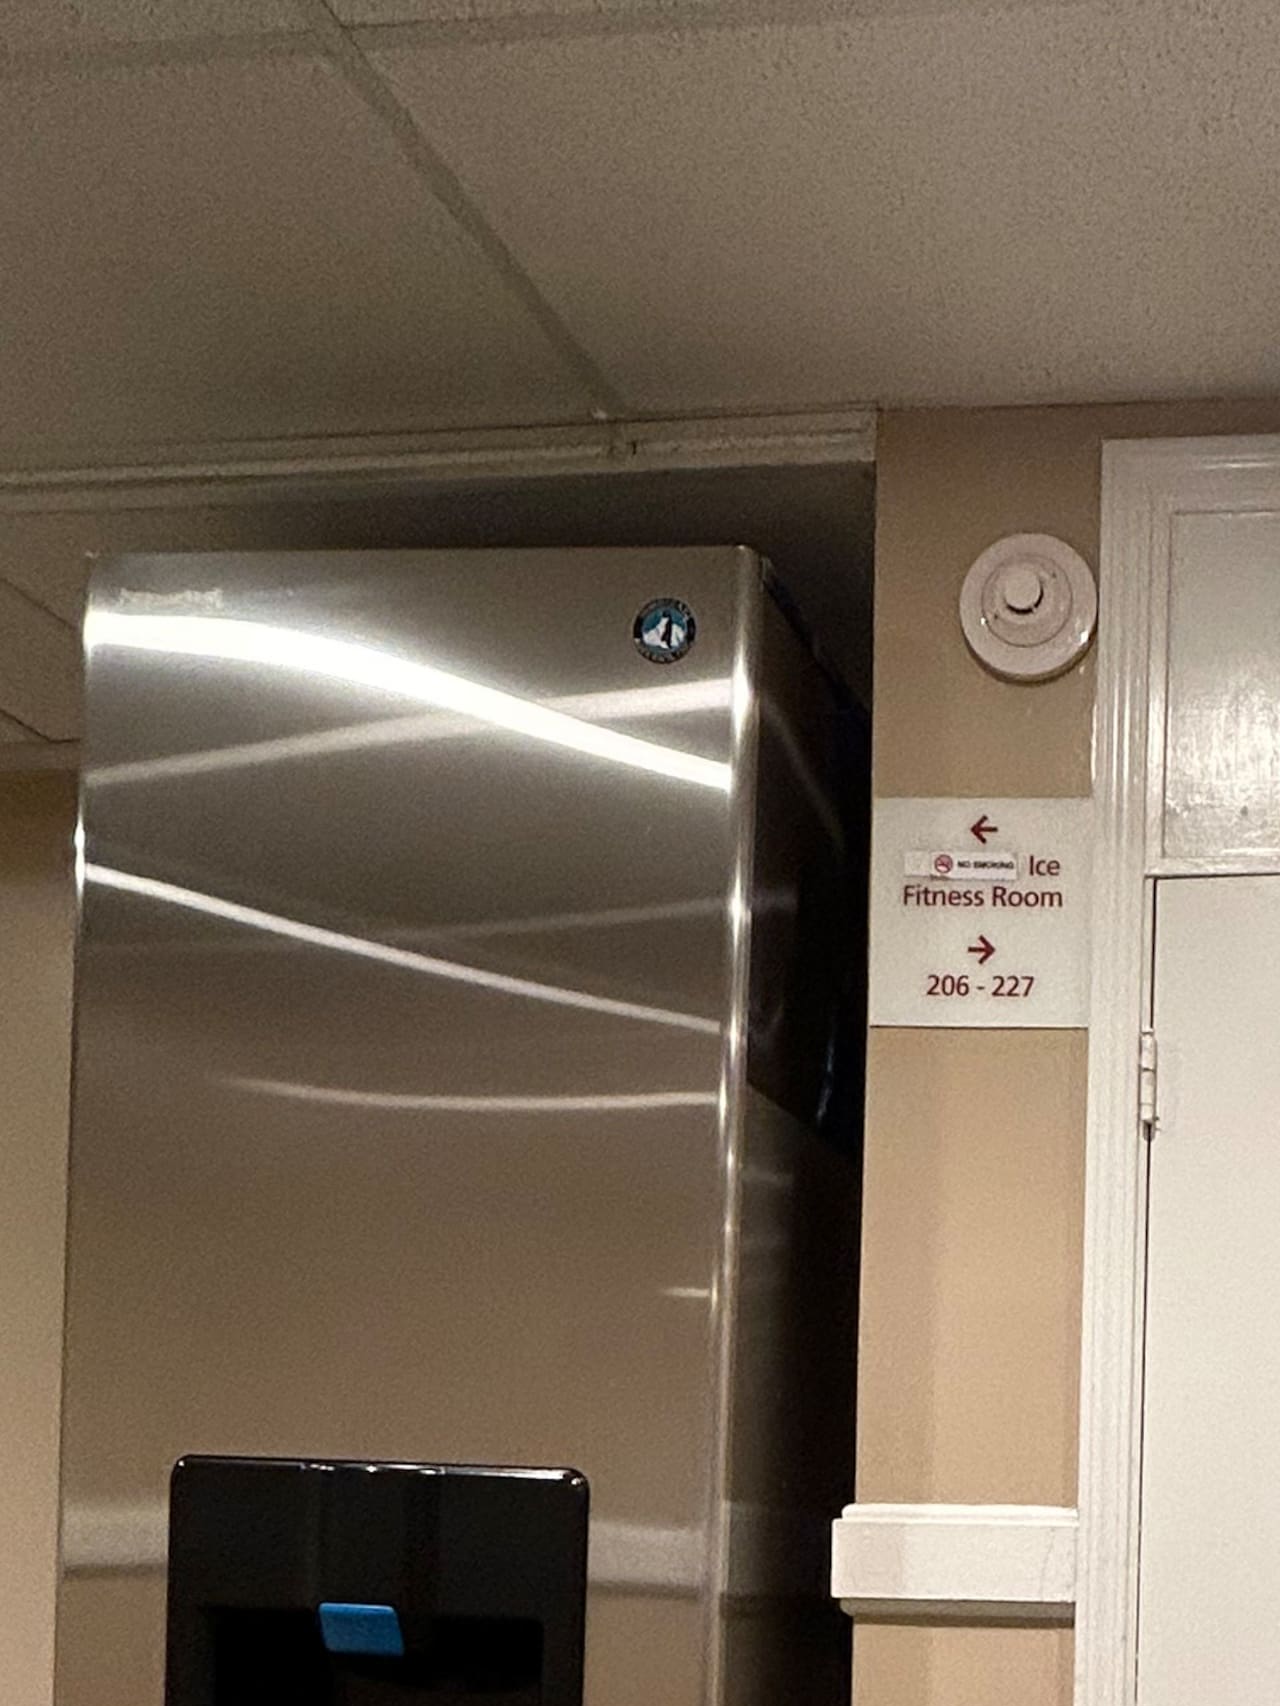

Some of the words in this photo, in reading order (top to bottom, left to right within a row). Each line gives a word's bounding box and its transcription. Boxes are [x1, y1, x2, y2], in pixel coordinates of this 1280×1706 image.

[1029, 855, 1060, 876] Ice
[903, 885, 984, 906] Fitness
[992, 886, 1063, 908] Room
[926, 974, 969, 996] 206
[991, 976, 1034, 997] 227
